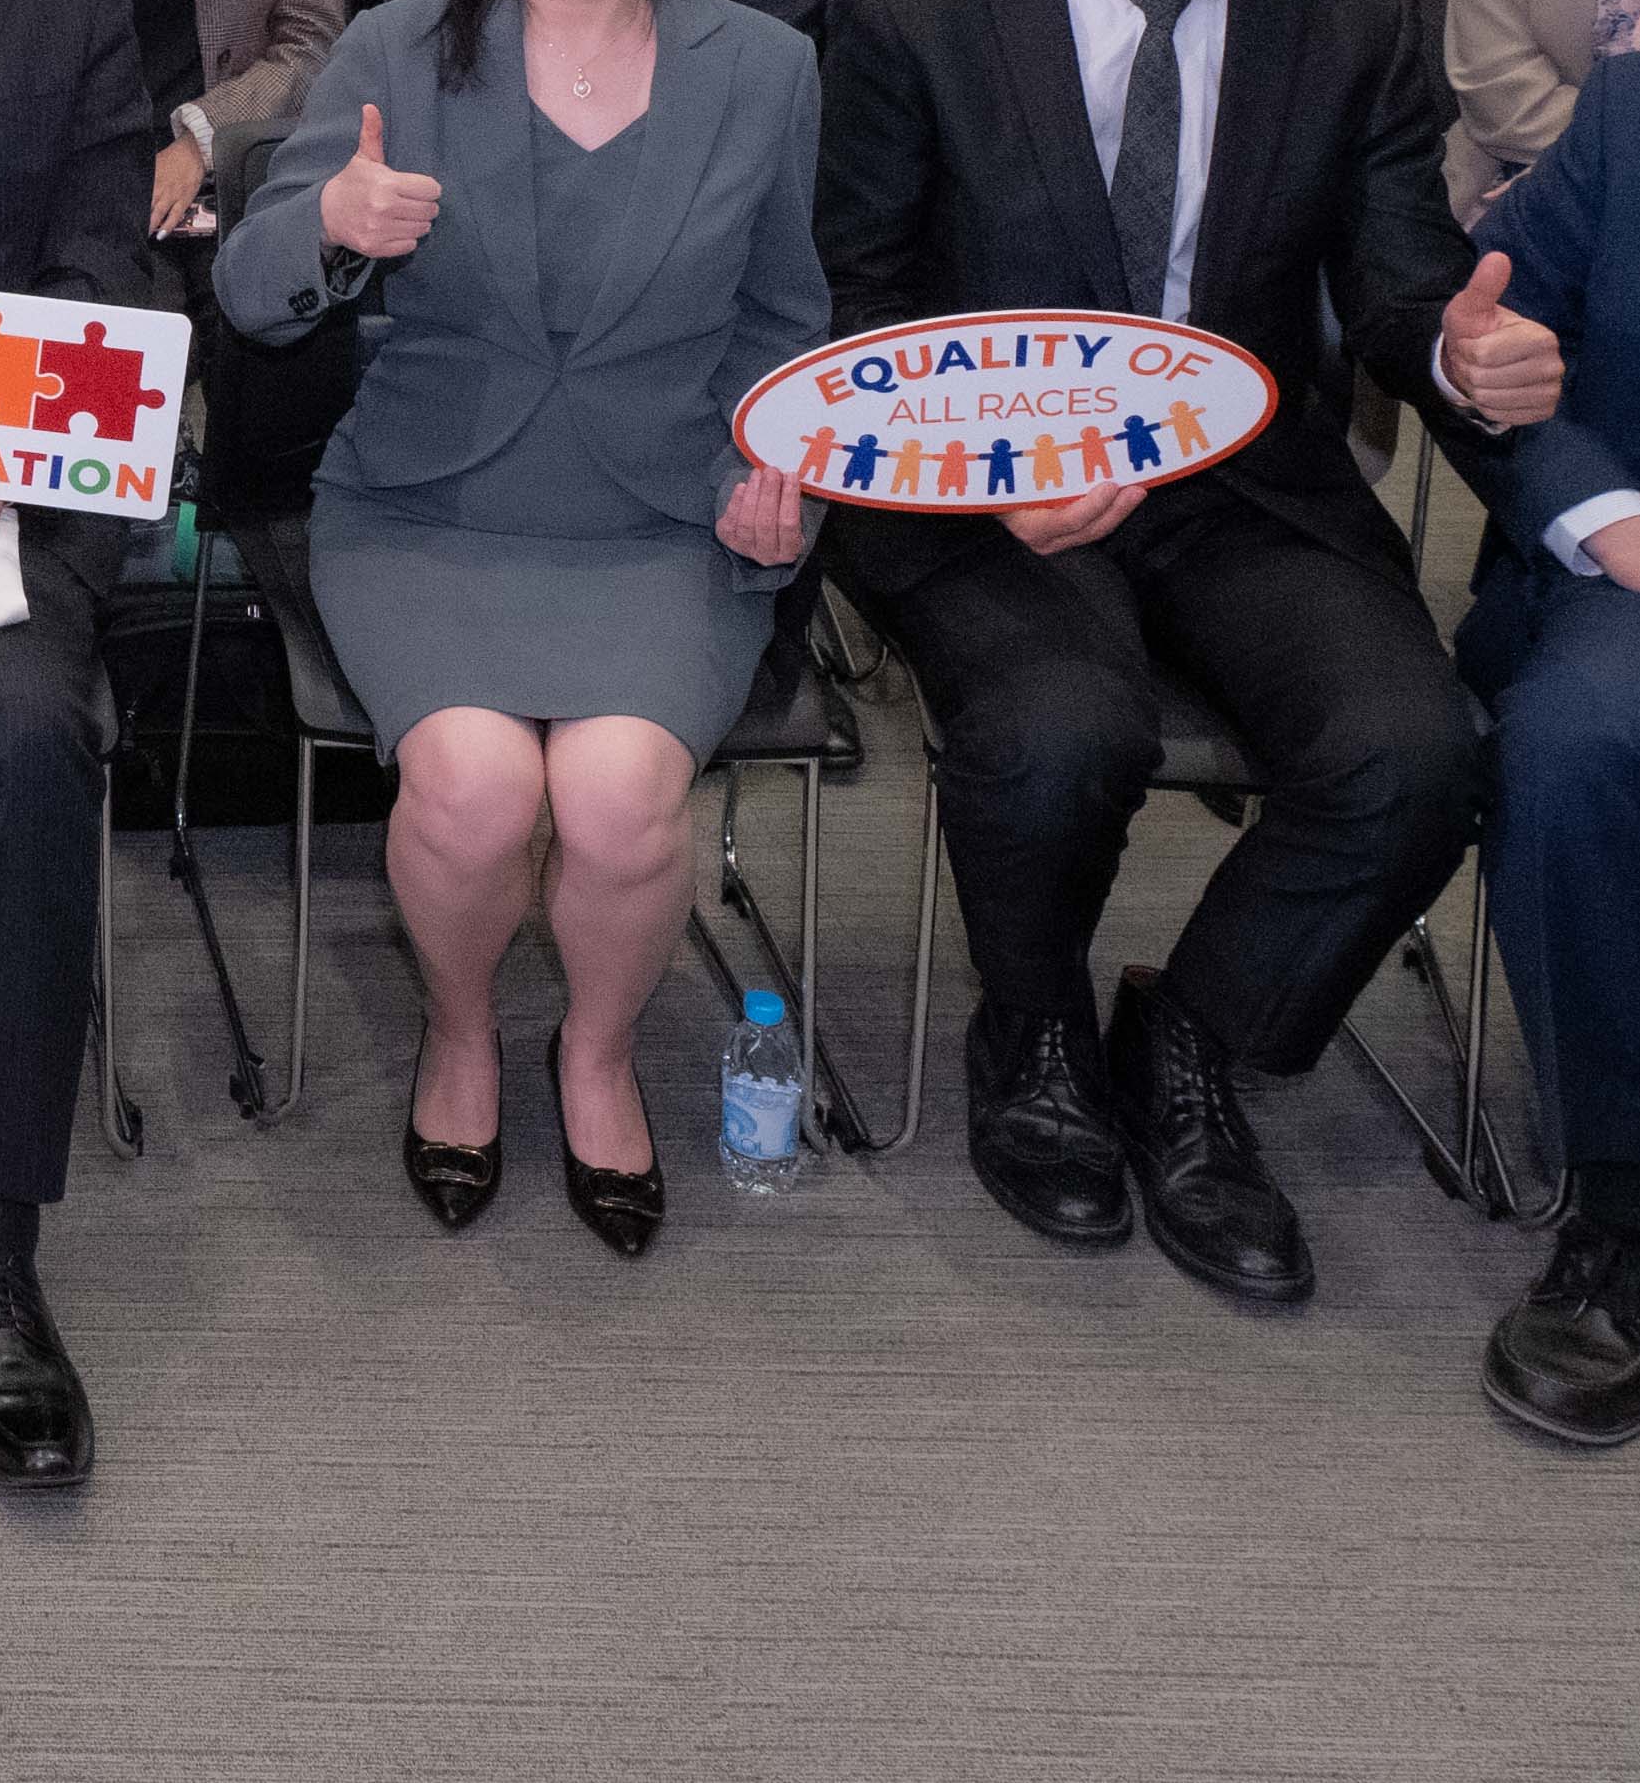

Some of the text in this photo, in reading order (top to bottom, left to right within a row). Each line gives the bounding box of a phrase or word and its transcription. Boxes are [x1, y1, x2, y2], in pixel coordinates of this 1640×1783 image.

[814, 334, 1213, 406] EQUALITY OF
[887, 386, 1118, 426] ALL RACES
